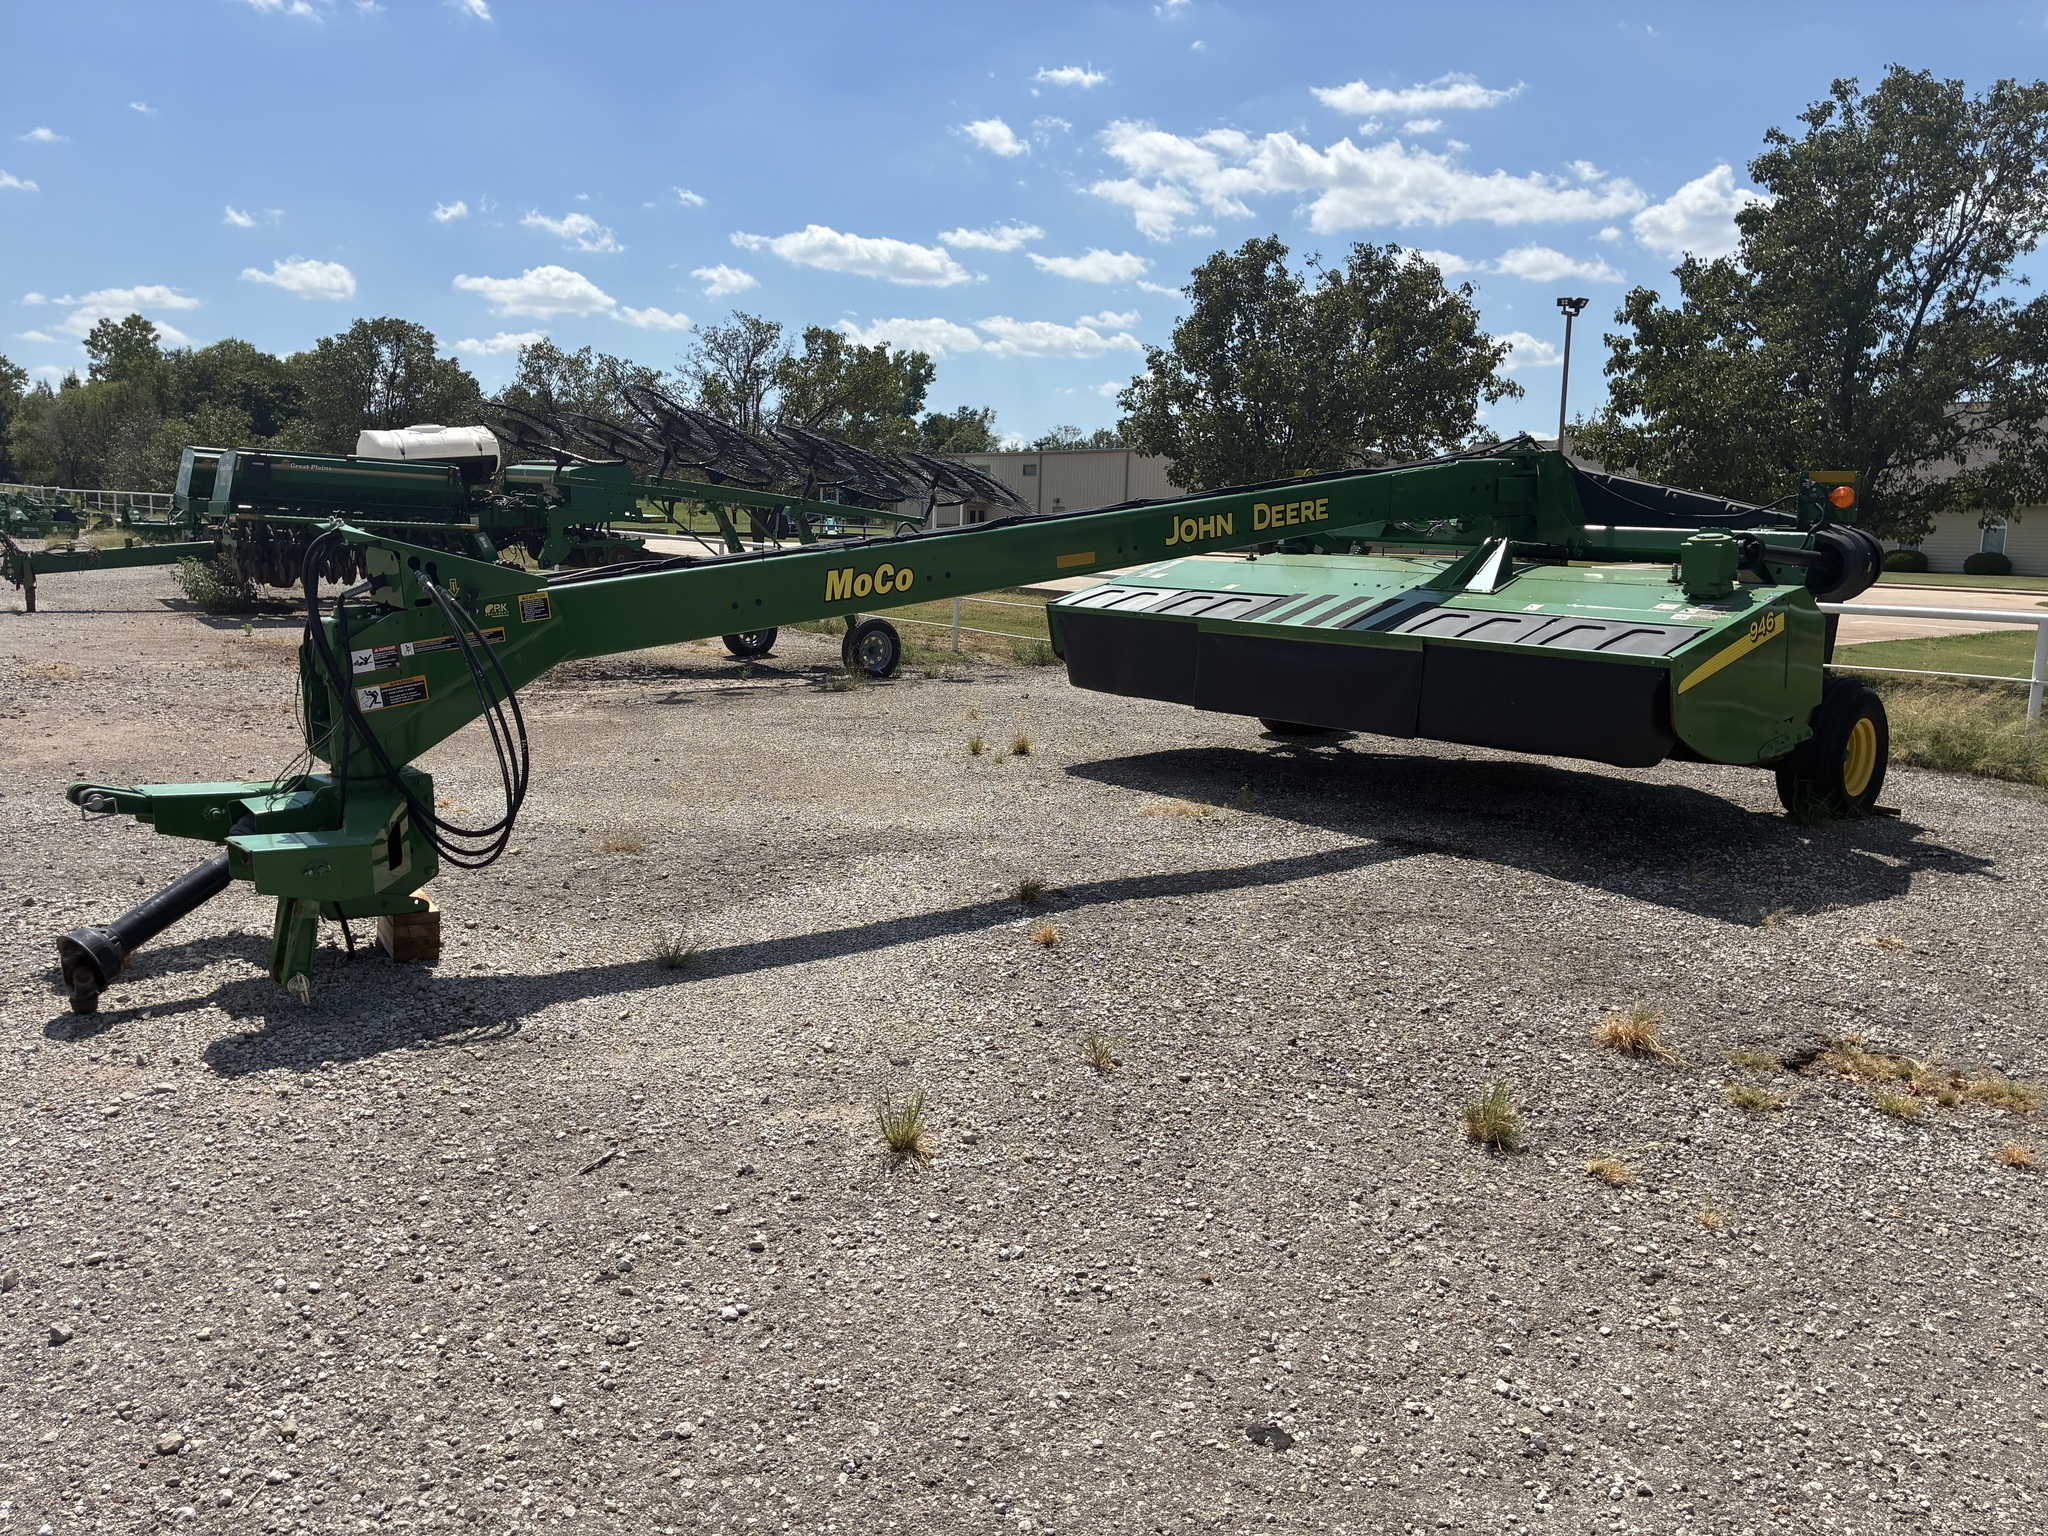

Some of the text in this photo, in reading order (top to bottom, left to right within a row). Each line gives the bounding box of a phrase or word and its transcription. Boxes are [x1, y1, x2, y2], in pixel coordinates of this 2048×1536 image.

[311, 463, 332, 471] Plains
[1165, 498, 1329, 546] JOHN DEERE
[825, 562, 914, 602] MoCo
[1750, 611, 1775, 642] 946
